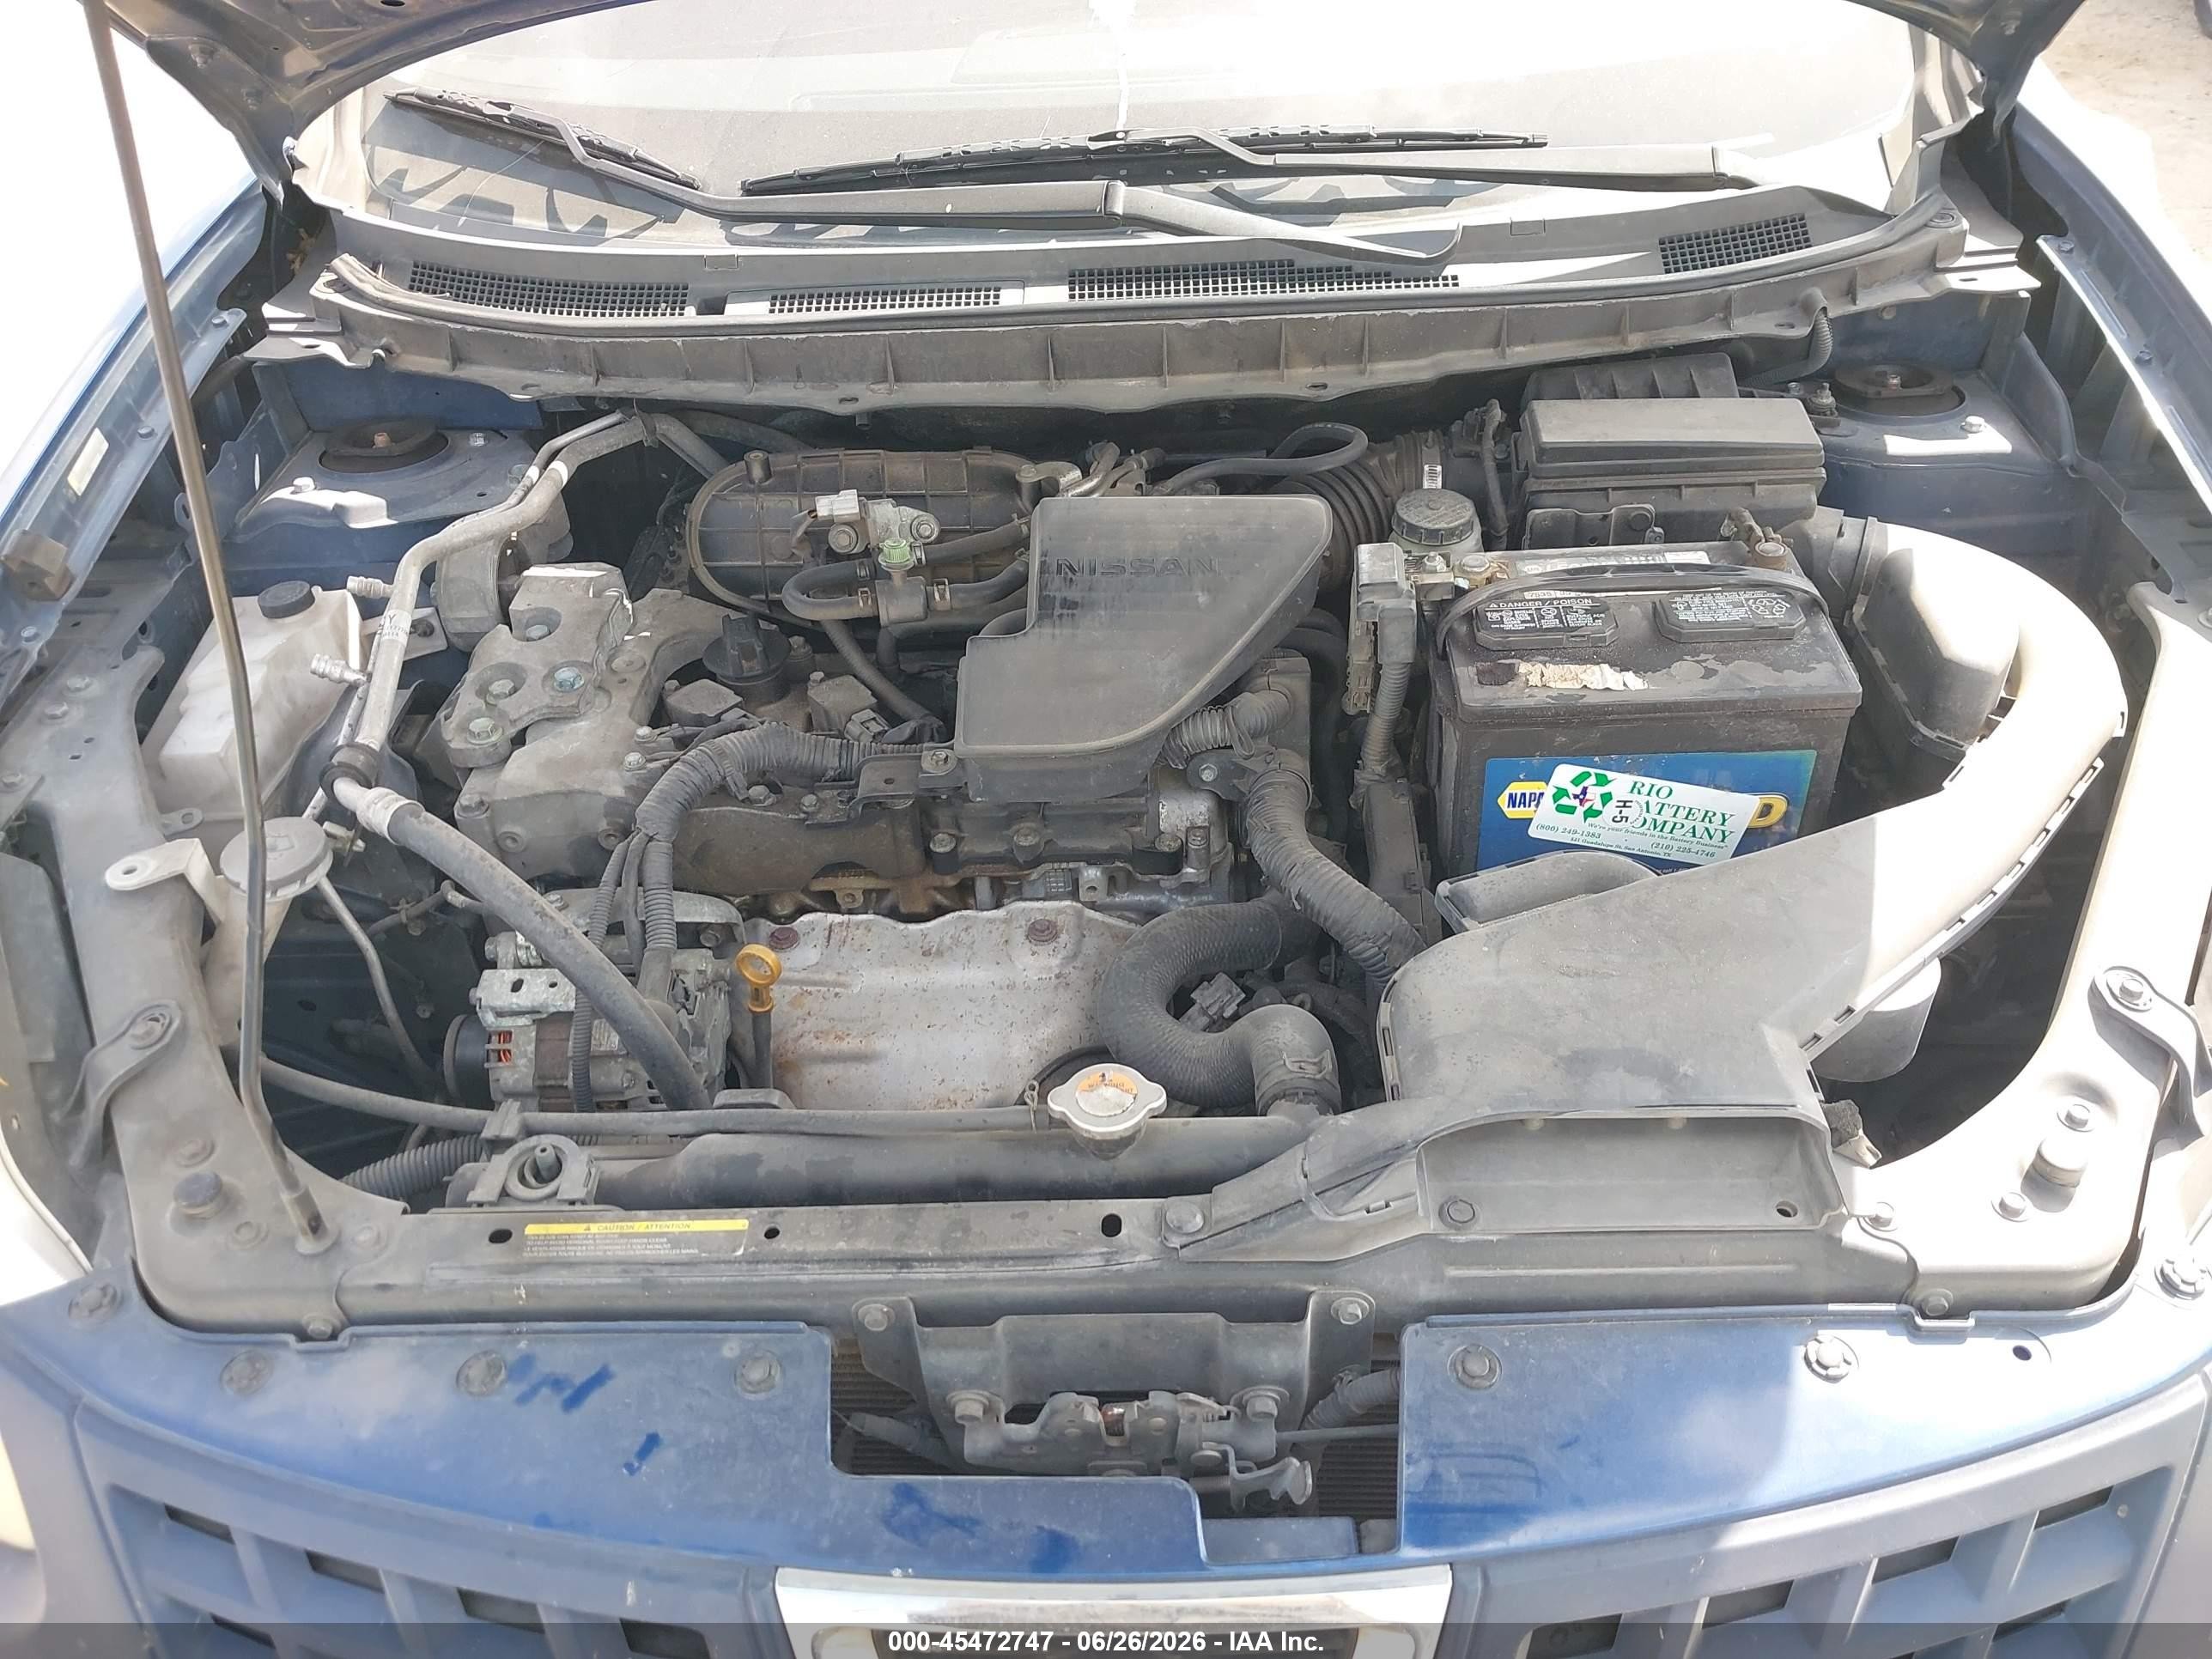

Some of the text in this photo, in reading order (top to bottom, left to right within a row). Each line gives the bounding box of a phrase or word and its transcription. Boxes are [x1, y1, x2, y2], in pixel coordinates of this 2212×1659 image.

[1056, 557, 1219, 577] NISSAN
[1628, 780, 1673, 799] RIO
[1612, 799, 1633, 823] H-5
[1644, 799, 1735, 826] ATTERY
[1536, 823, 1601, 839] (800) 249-1383
[1632, 816, 1735, 843] OMPANY
[1650, 842, 1716, 858] (210) 225-4746
[1669, 836, 1693, 845] Battery
[597, 1223, 635, 1231] CAUTION
[645, 1222, 691, 1231] ATTENTION
